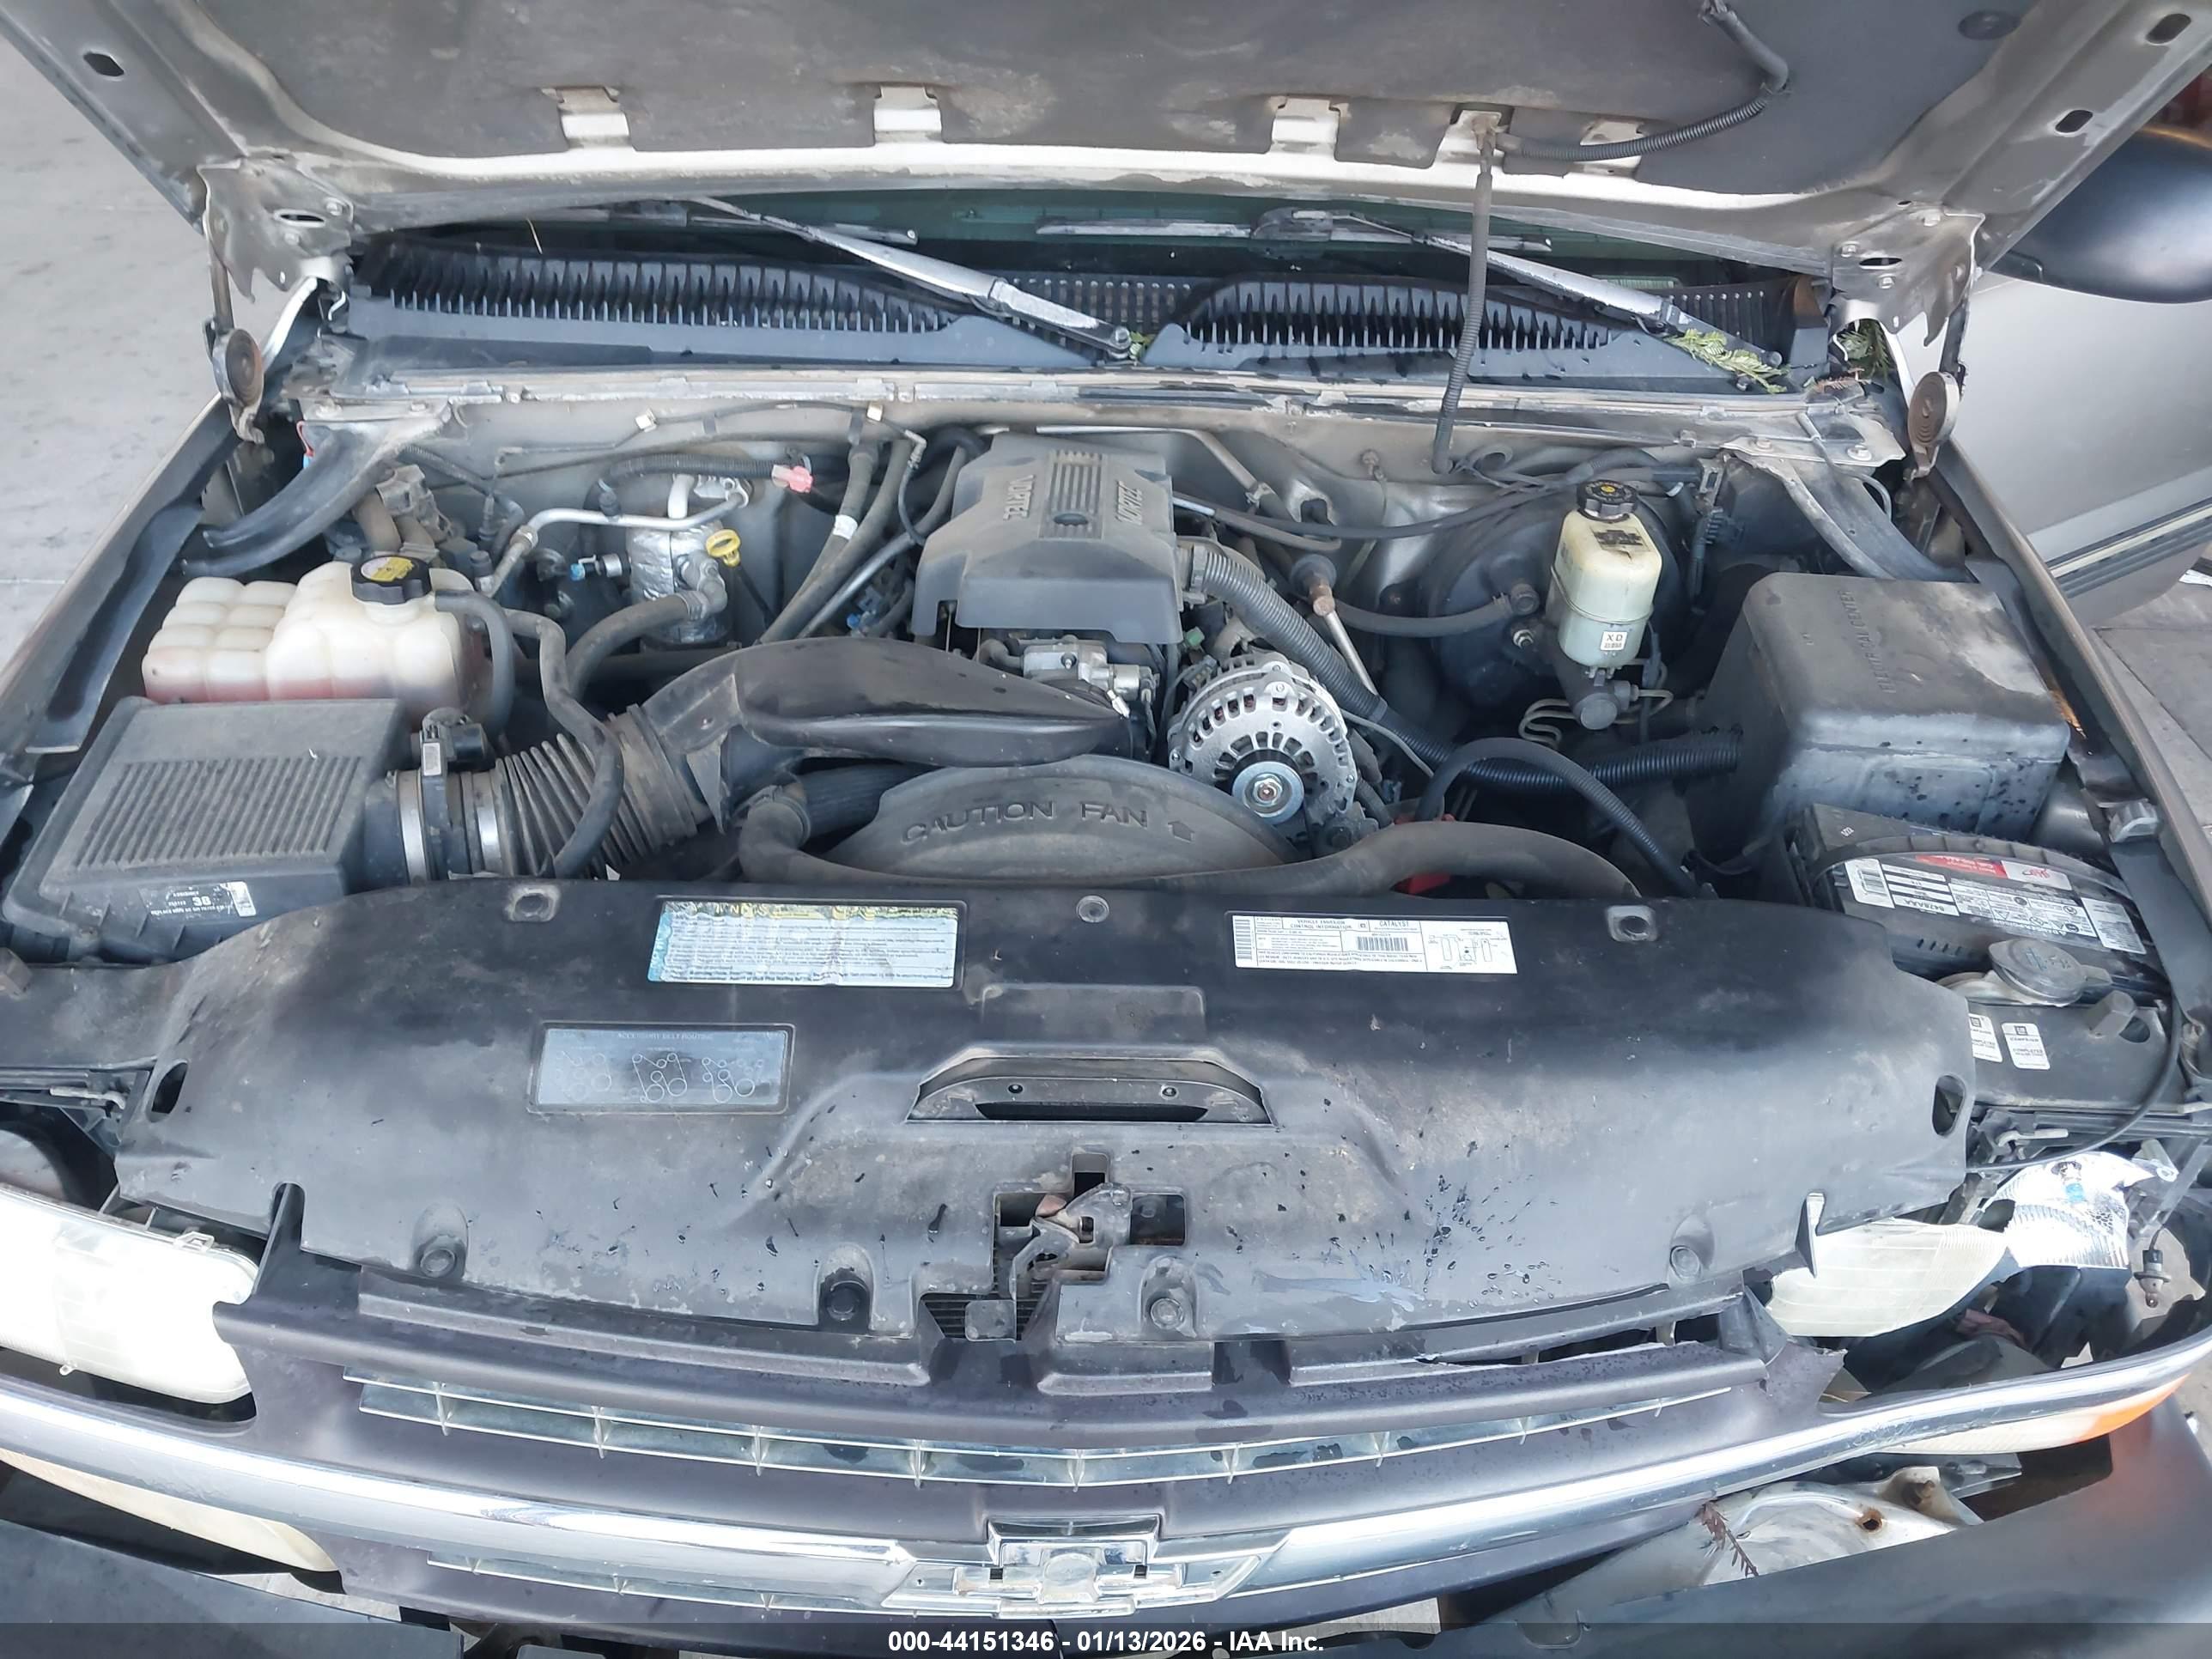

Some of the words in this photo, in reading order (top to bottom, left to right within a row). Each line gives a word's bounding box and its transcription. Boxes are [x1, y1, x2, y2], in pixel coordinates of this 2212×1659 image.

[1003, 474, 1036, 520] VORTEC
[1115, 480, 1143, 526] VORTEC
[901, 801, 1055, 846] CAUTION
[1079, 801, 1149, 829] FAN
